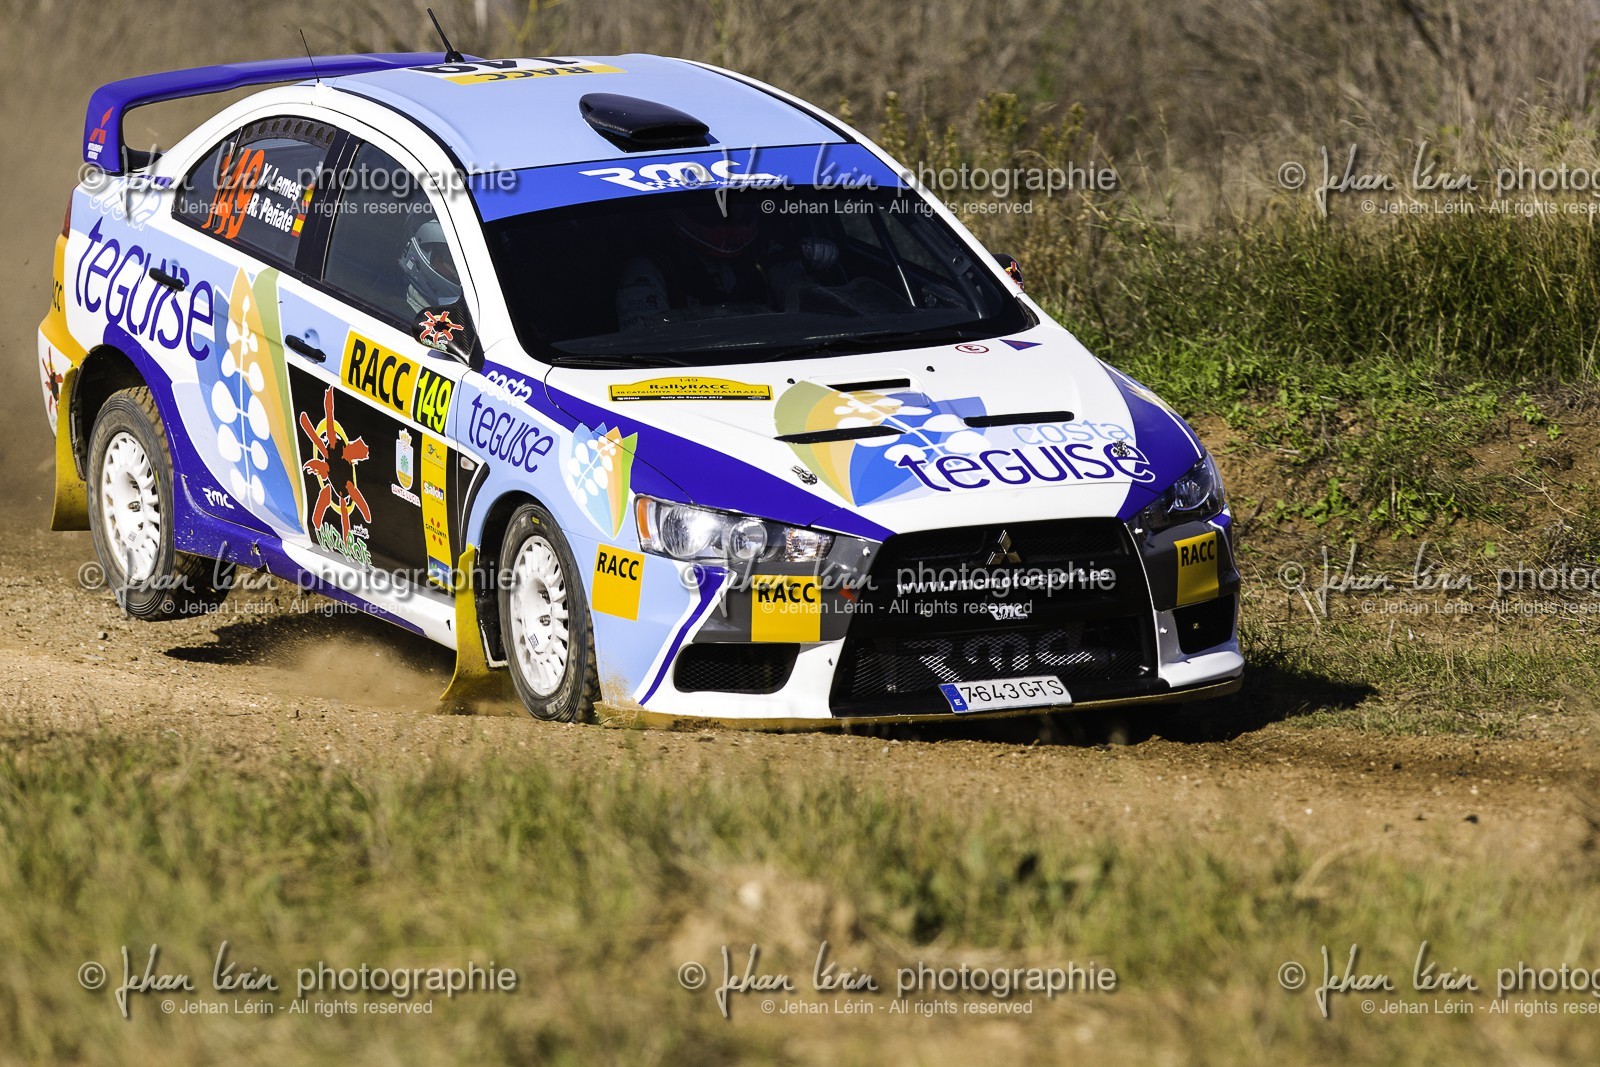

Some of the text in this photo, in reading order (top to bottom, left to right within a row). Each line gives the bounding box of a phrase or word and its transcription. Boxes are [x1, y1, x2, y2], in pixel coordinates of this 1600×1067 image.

[475, 66, 593, 81] RACC
[201, 147, 265, 239] 149
[267, 167, 302, 202] Lemes
[258, 196, 294, 233] Peñate
[349, 337, 453, 434] RACC 149
[1010, 419, 1136, 446] costa
[596, 550, 640, 582] RACC
[1179, 539, 1216, 567] RACC
[757, 581, 818, 605] RACC
[896, 567, 1112, 595] www.rmcmotorsport.es
